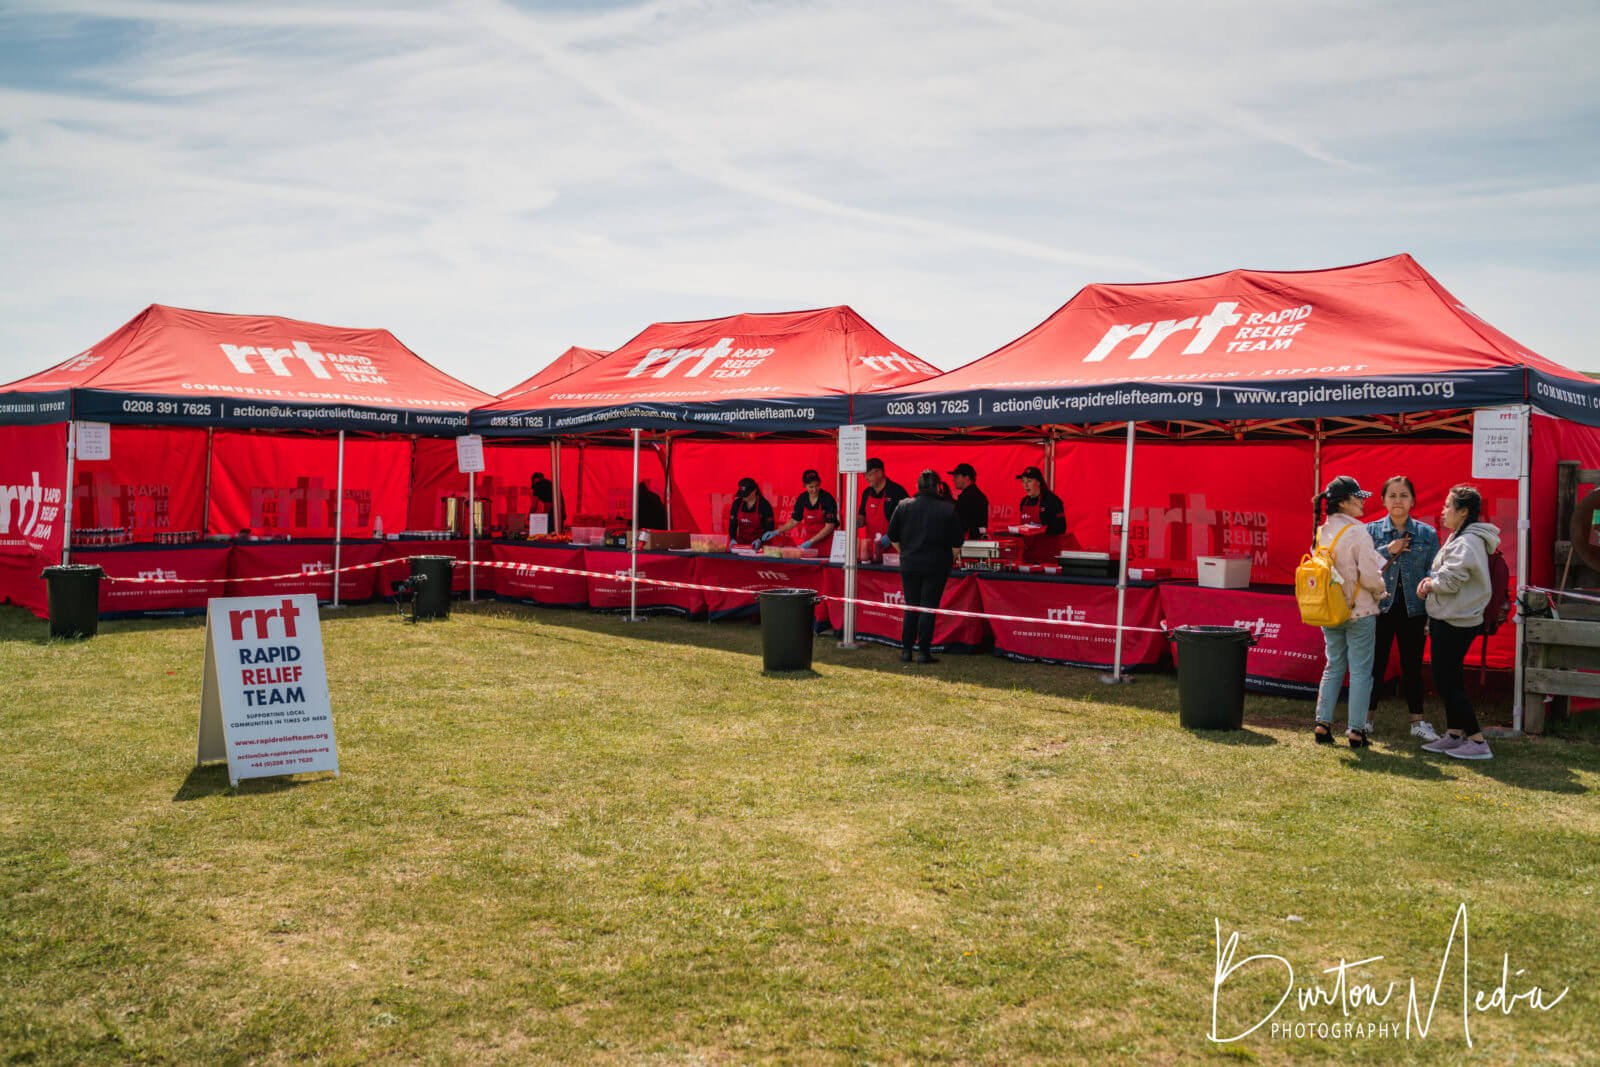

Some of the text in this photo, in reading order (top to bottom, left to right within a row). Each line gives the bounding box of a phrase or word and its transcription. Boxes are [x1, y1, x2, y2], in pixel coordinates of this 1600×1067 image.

[1246, 304, 1312, 325] RAPID
[1082, 302, 1243, 363] rrt
[1235, 323, 1304, 339] RELIEF
[731, 348, 775, 358] RAPID
[1225, 338, 1293, 353] TEAM
[219, 340, 332, 380] rrt
[326, 353, 372, 365] RAPID
[624, 337, 735, 378] rrt
[720, 358, 765, 369] RELIEF
[334, 363, 378, 375] RELIEF
[709, 369, 752, 378] TEAM
[1261, 364, 1369, 377] SUPPORT
[342, 374, 388, 384] TEAM
[181, 382, 283, 397] COMMUNITY
[549, 392, 620, 400] COMMUNITY
[886, 380, 1455, 415] 0208 391 7625 action@uk-rapidreliefteam.org www.rapidreliefteam.org
[1537, 381, 1586, 406] COMMUNITY
[40, 401, 65, 412] SUPPORT
[122, 400, 154, 413] 0208
[156, 402, 178, 414] 391
[182, 403, 211, 415] 7625
[233, 405, 398, 424] action@uk-rapidreliefteam.org
[524, 417, 544, 427] 7625
[694, 407, 816, 423] www.rapidreliefteam.org
[127, 484, 170, 497] RAPID
[1222, 510, 1268, 527] RAPID
[1223, 529, 1269, 547] RELIEF
[229, 599, 299, 641] rrt
[1047, 605, 1073, 623] rrt
[239, 646, 301, 665] RAPID
[241, 666, 303, 686] RELIEF
[243, 686, 306, 707] TEAM
[246, 711, 285, 719] SUPPORTING
[230, 720, 273, 728] COMMUNITIES
[235, 733, 329, 747] www.rapidreliefteam.org
